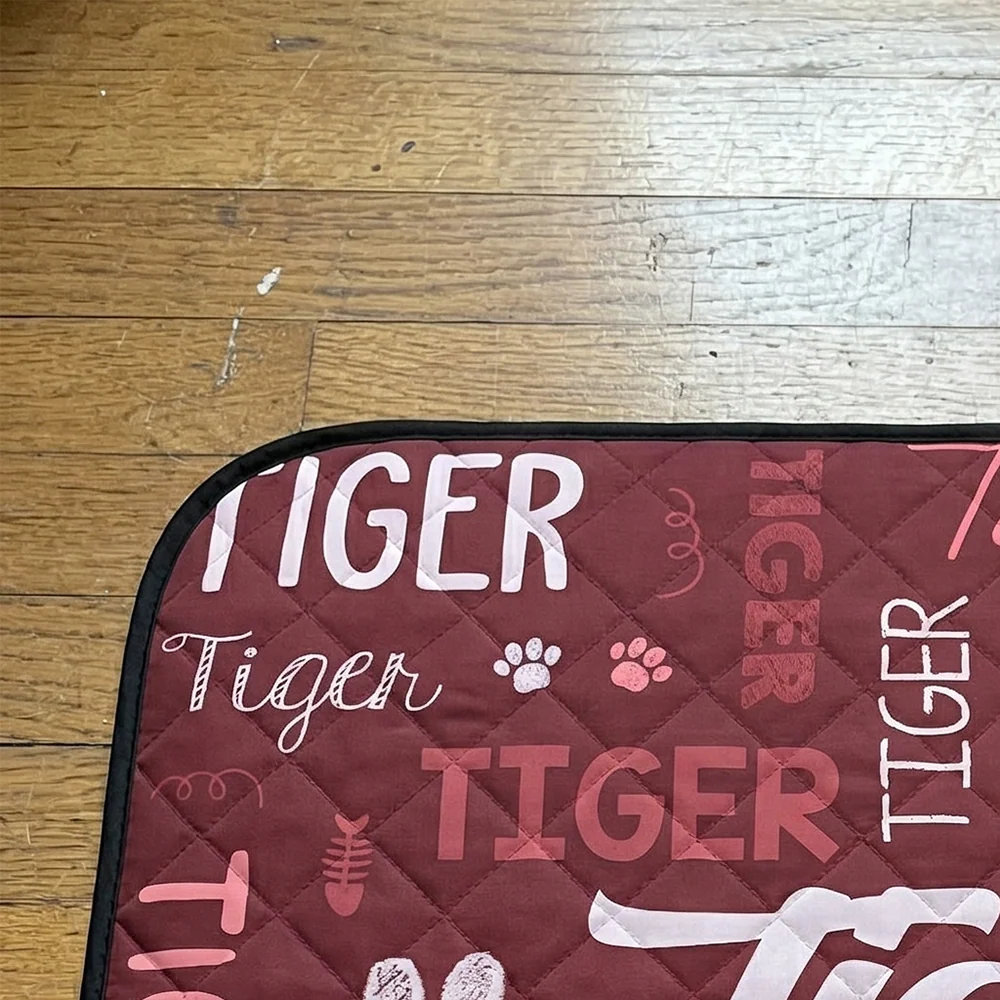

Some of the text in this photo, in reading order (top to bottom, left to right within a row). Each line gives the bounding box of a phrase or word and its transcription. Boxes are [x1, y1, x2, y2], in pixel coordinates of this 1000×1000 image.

[200, 452, 584, 594] TIGER
[741, 449, 824, 709] TIGER
[161, 630, 443, 754] Tiger
[878, 595, 971, 843] TIGER
[420, 744, 840, 864] TIGER
